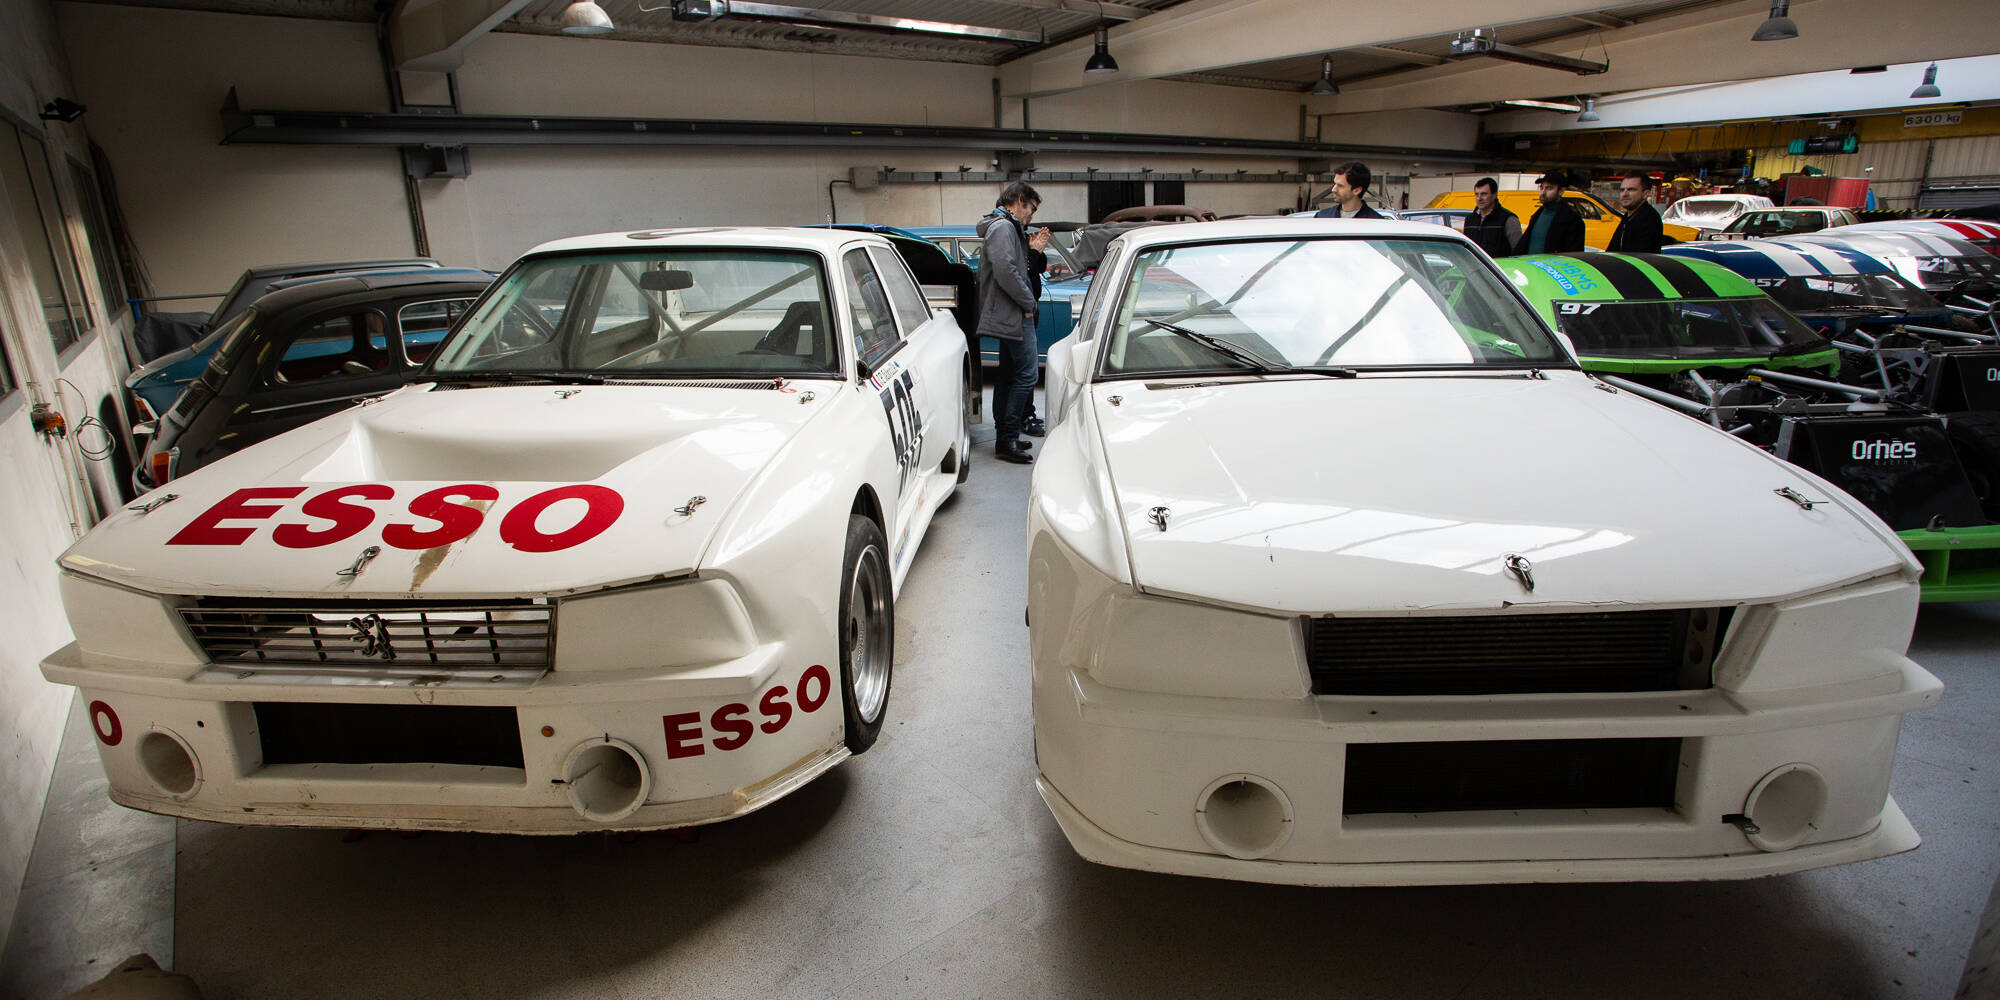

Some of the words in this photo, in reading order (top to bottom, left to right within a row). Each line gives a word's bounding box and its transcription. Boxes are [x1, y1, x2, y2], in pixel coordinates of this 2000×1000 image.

[1906, 114, 1942, 125] 6300
[1560, 302, 1601, 315] 97
[1986, 367, 2000, 382] O
[165, 484, 625, 553] ESSO
[89, 700, 123, 746] O
[663, 665, 831, 759] ESSO
